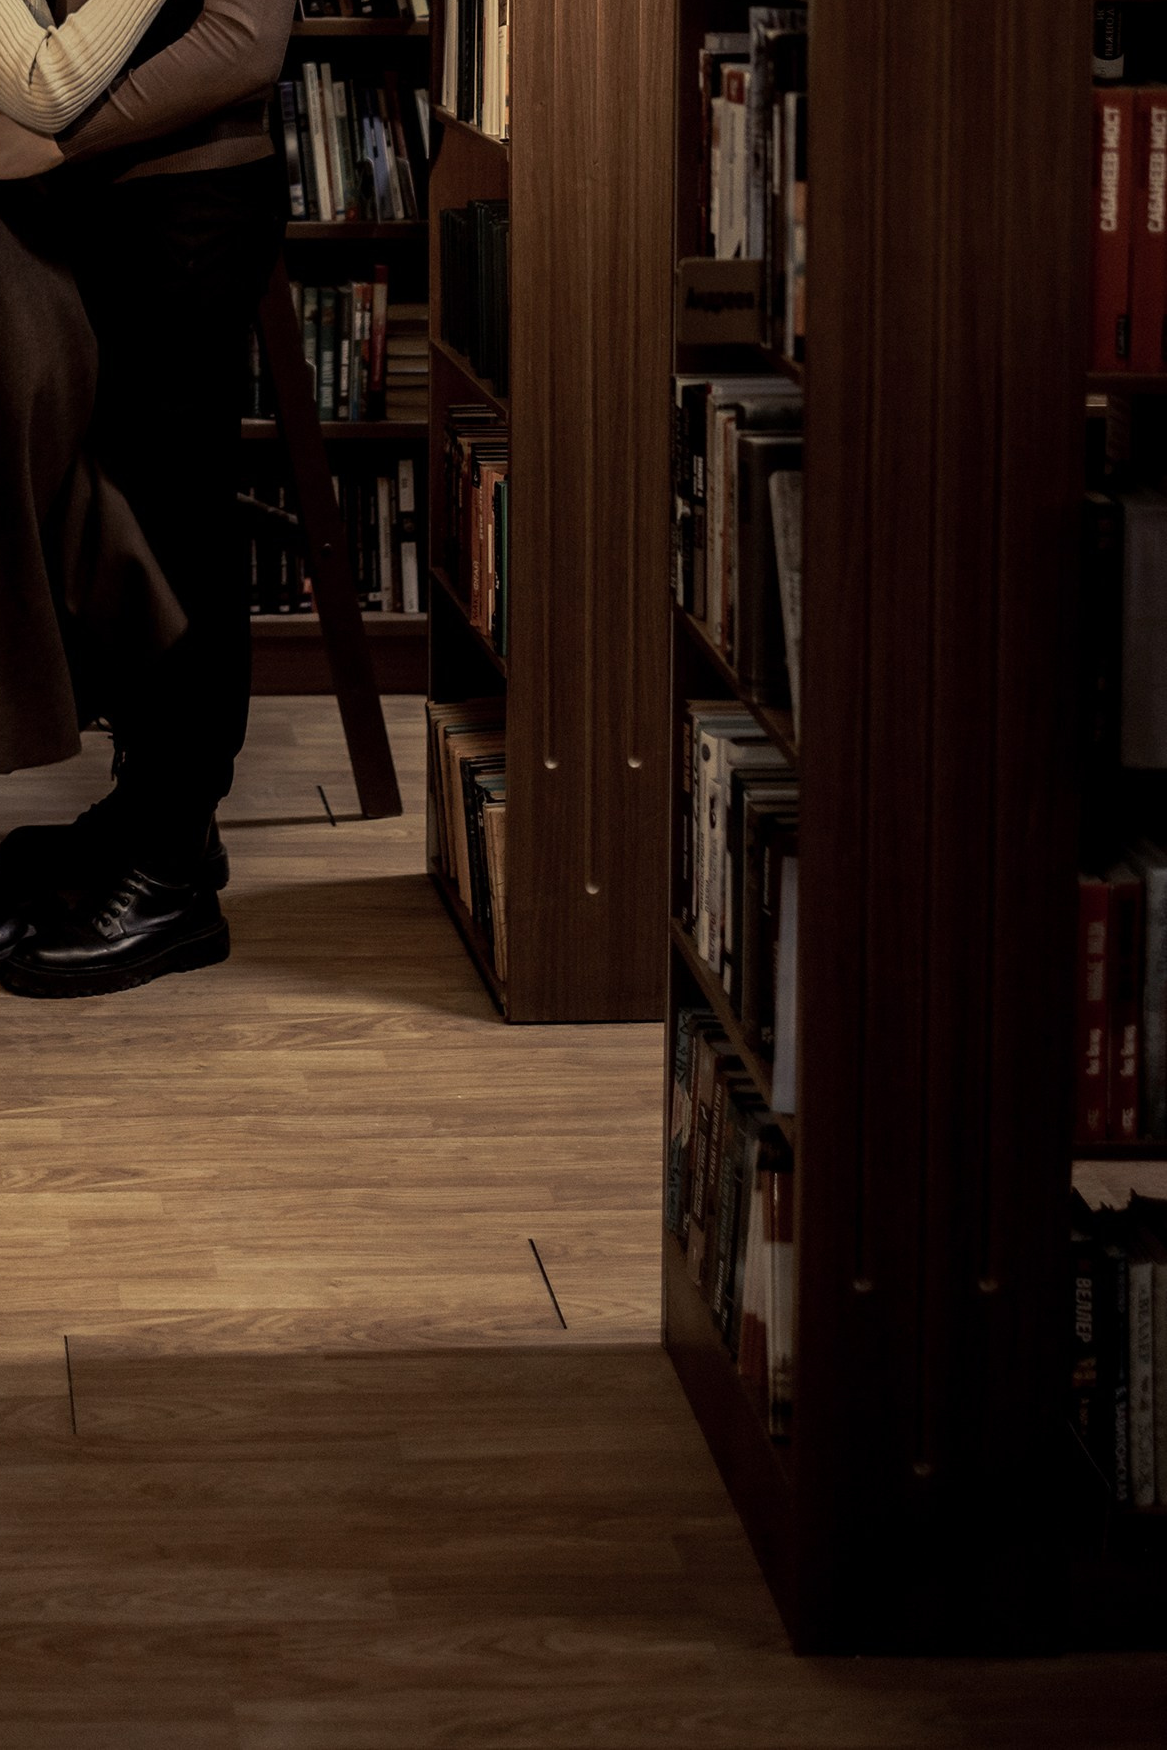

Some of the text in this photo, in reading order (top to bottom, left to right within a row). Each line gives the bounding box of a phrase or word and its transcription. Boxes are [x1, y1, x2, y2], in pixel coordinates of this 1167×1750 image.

[1100, 105, 1122, 232] САБАНЕЕВ МОСТ
[1147, 106, 1167, 233] САБАНЕЕВ МОСТ
[1075, 1276, 1093, 1343] ВЕЛЛЕР
